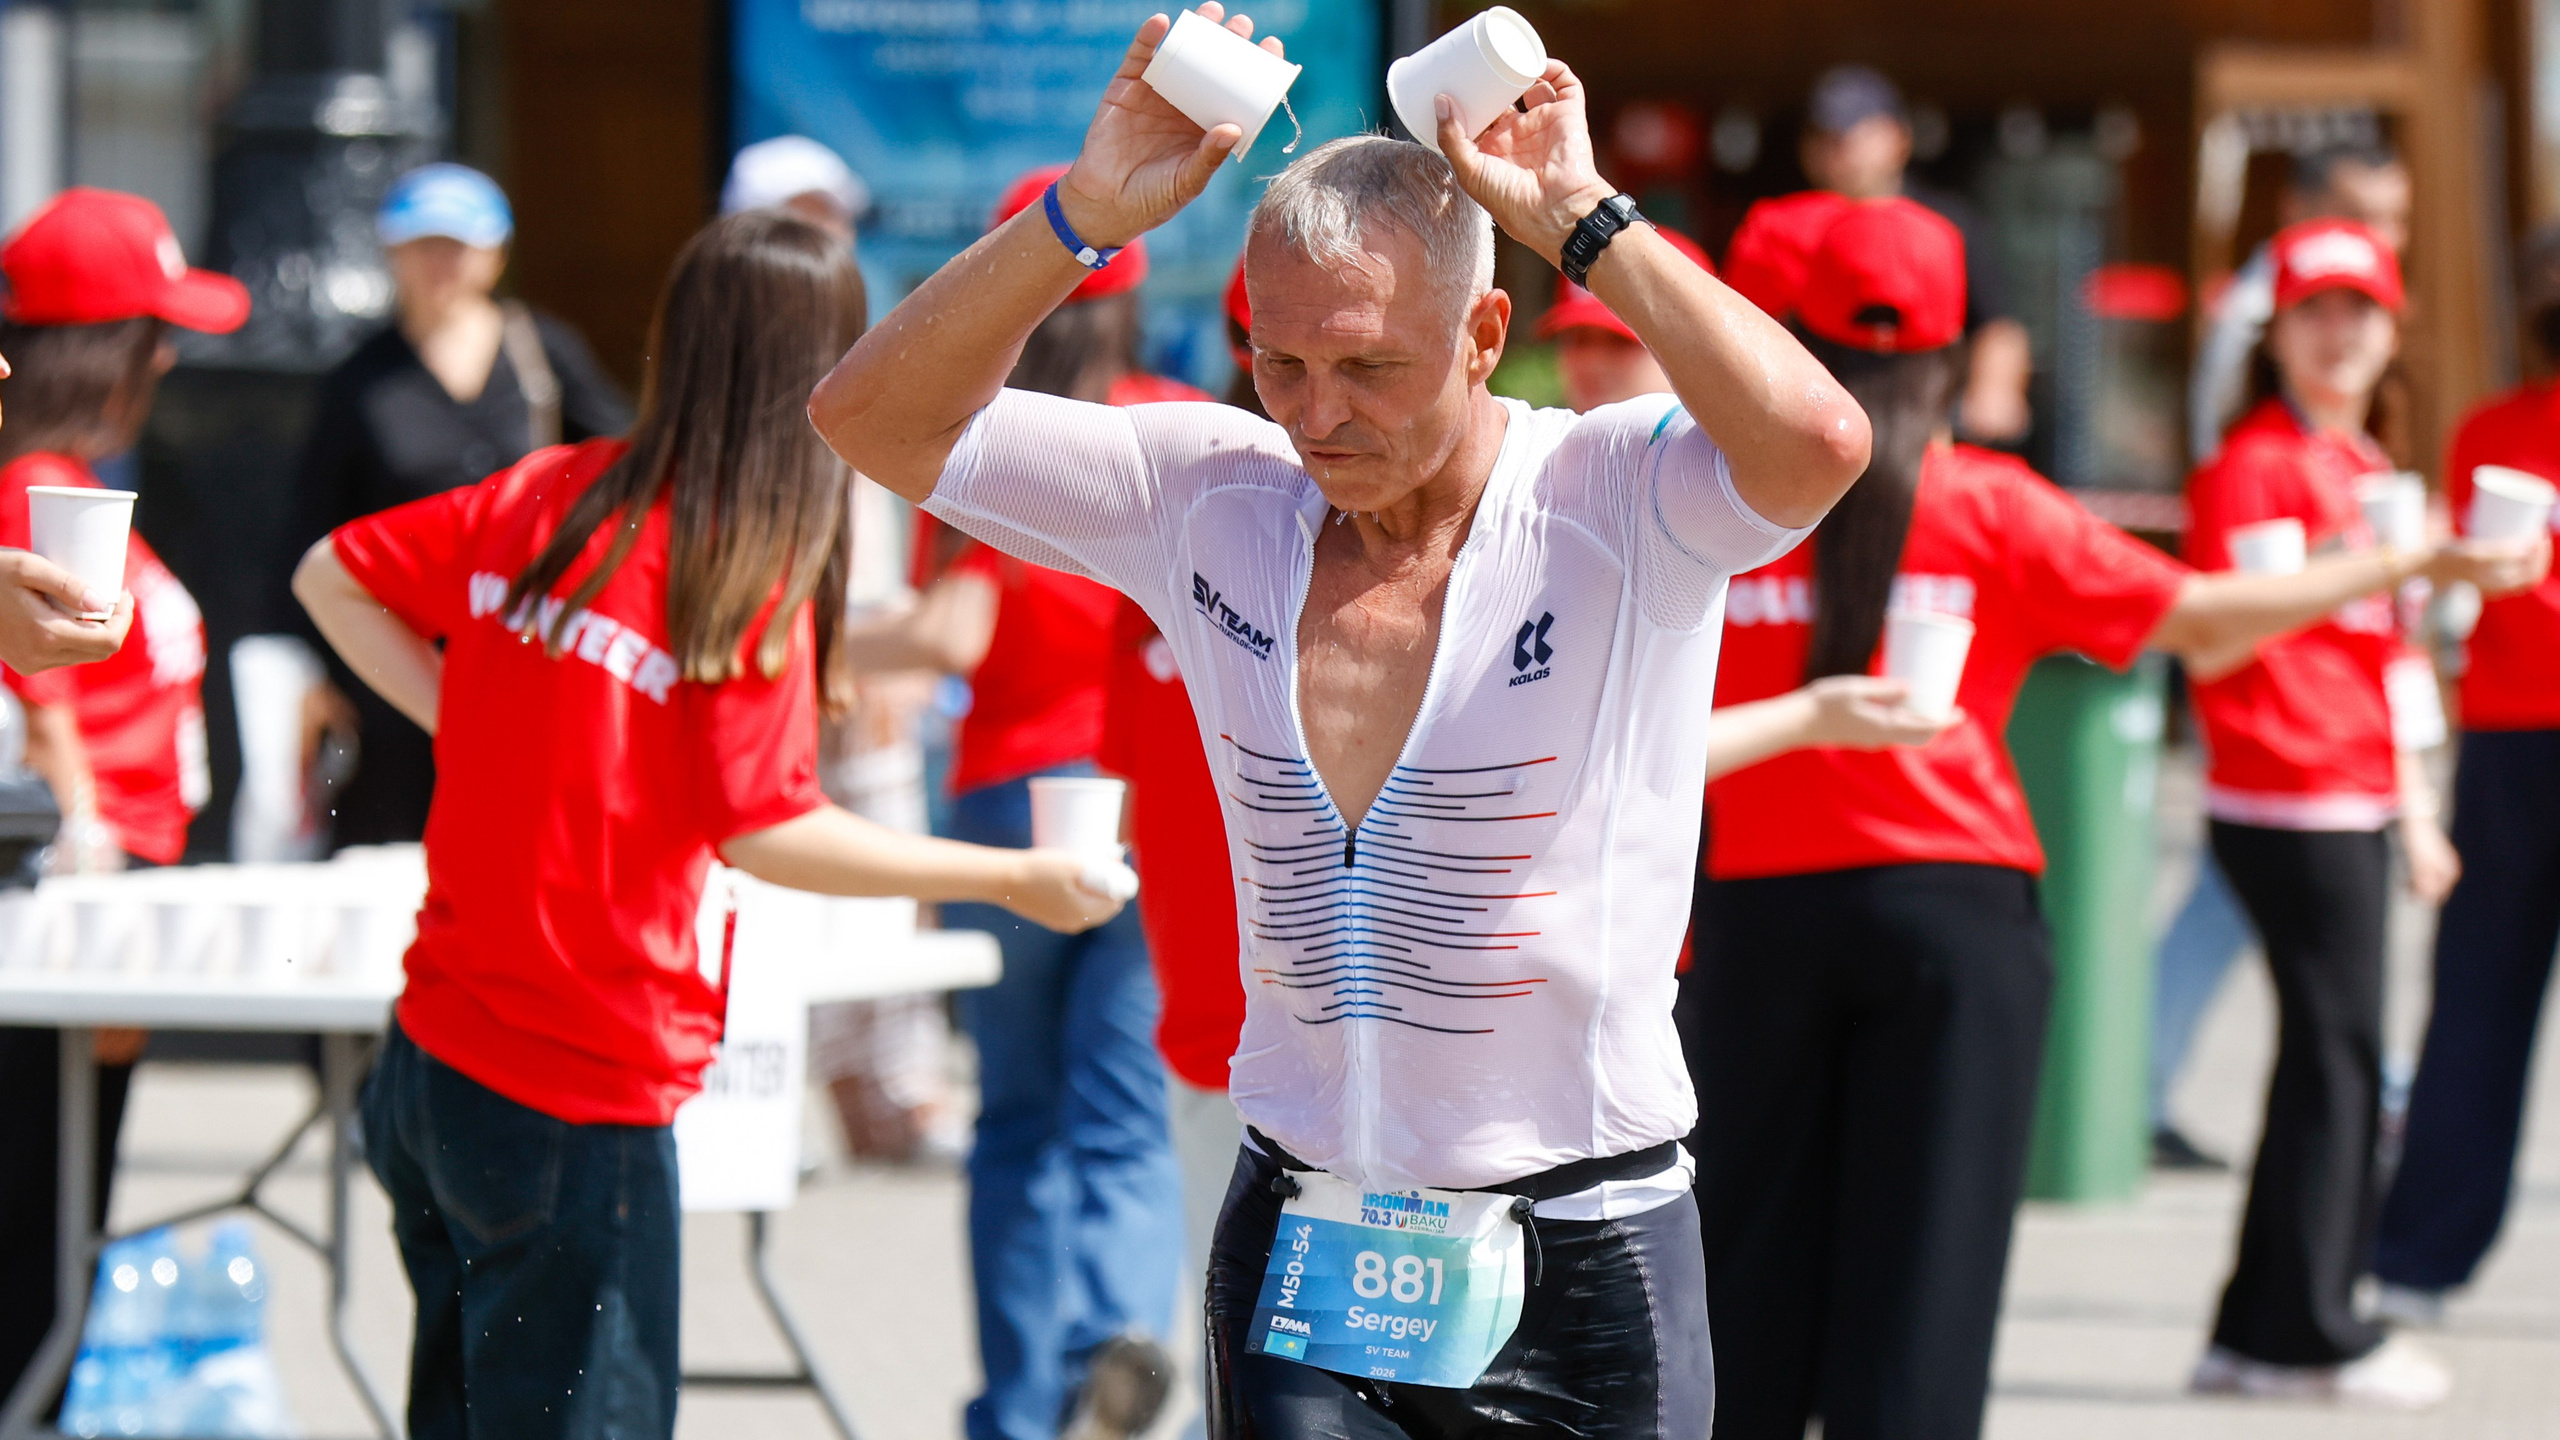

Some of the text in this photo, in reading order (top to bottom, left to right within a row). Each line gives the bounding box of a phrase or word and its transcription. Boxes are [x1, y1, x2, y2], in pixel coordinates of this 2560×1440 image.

[1193, 571, 1221, 613] SV
[1219, 601, 1274, 653] TEAM
[1360, 1208, 1392, 1227] 70.3
[1361, 1191, 1450, 1218] IRONMAN
[1410, 1214, 1448, 1229] BAKU
[1277, 1224, 1313, 1309] M50-54
[1352, 1251, 1444, 1305] 881
[1345, 1306, 1438, 1343] Sergey
[1365, 1345, 1410, 1359] SV TEAM
[1369, 1366, 1396, 1378] 2026
